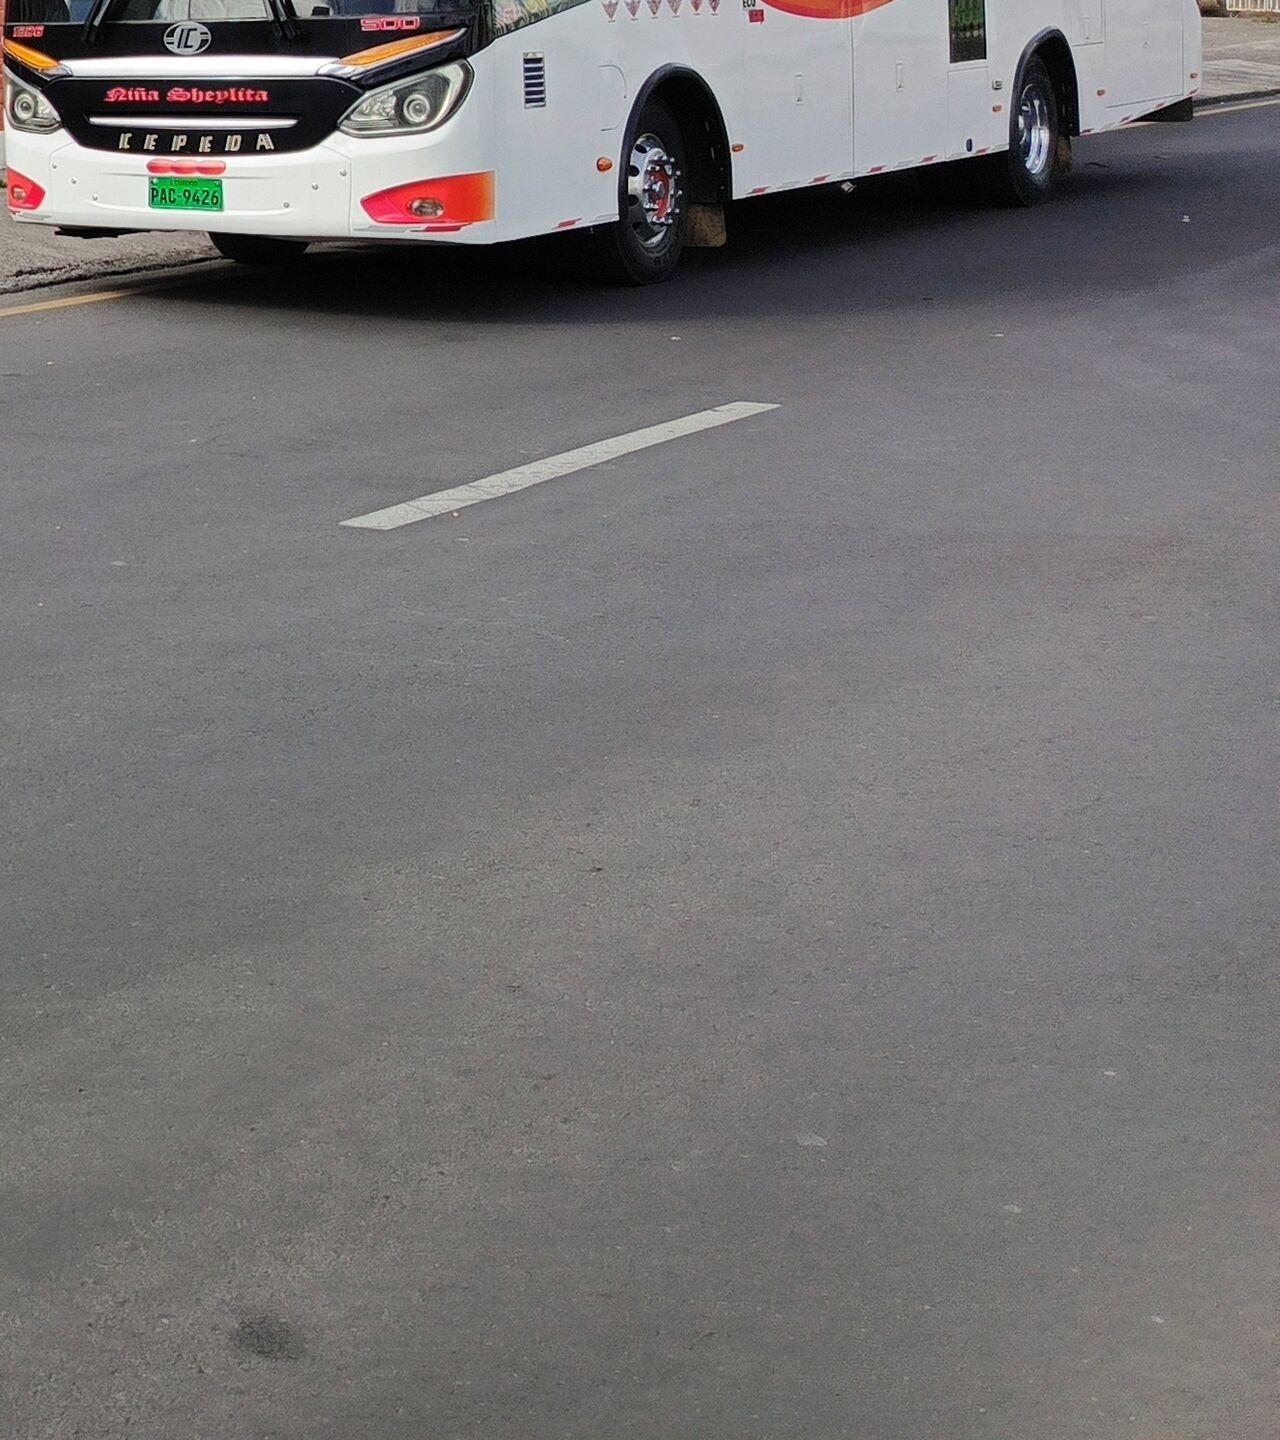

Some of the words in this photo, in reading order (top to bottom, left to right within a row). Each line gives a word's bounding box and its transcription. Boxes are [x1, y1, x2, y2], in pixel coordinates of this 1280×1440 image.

[361, 16, 420, 31] 500
[104, 87, 160, 101] Niña
[167, 87, 269, 104] Sheylita
[118, 132, 275, 153] CEPEDA
[150, 187, 220, 206] PAC-9426
